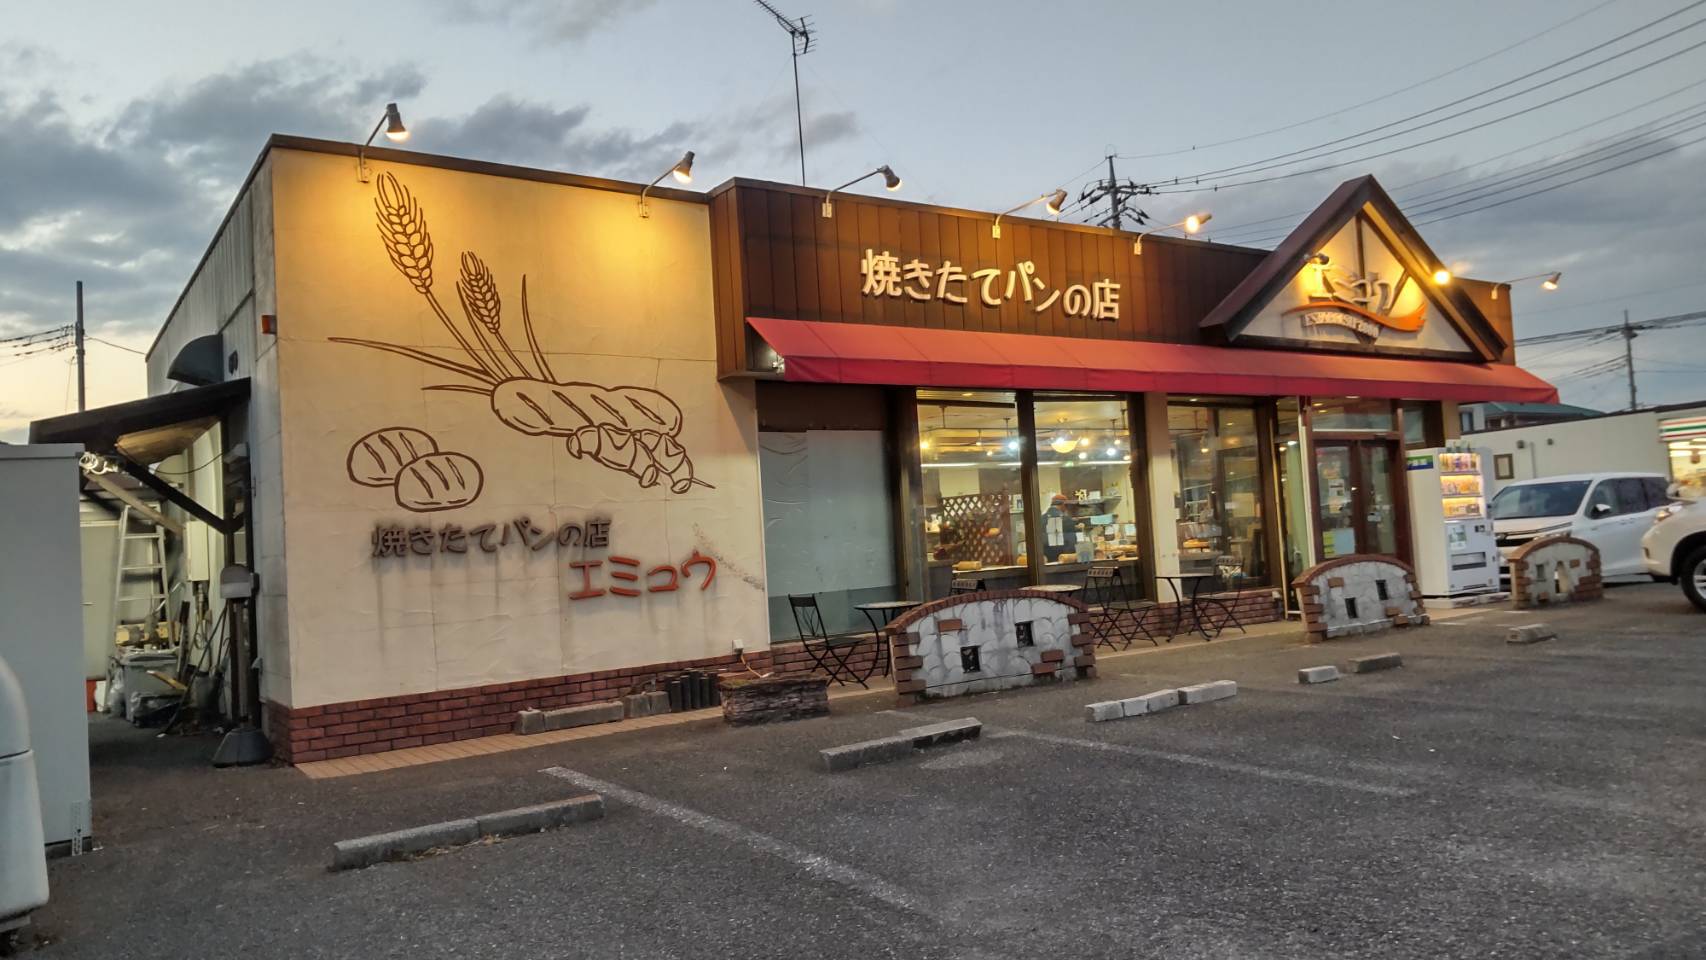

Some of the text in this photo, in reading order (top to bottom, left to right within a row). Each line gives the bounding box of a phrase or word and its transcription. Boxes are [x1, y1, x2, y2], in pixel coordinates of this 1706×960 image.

[861, 248, 1121, 320] 焼きたてパンの店
[371, 515, 612, 558] 焼きたてパンの店
[568, 549, 717, 600] エミコウ
